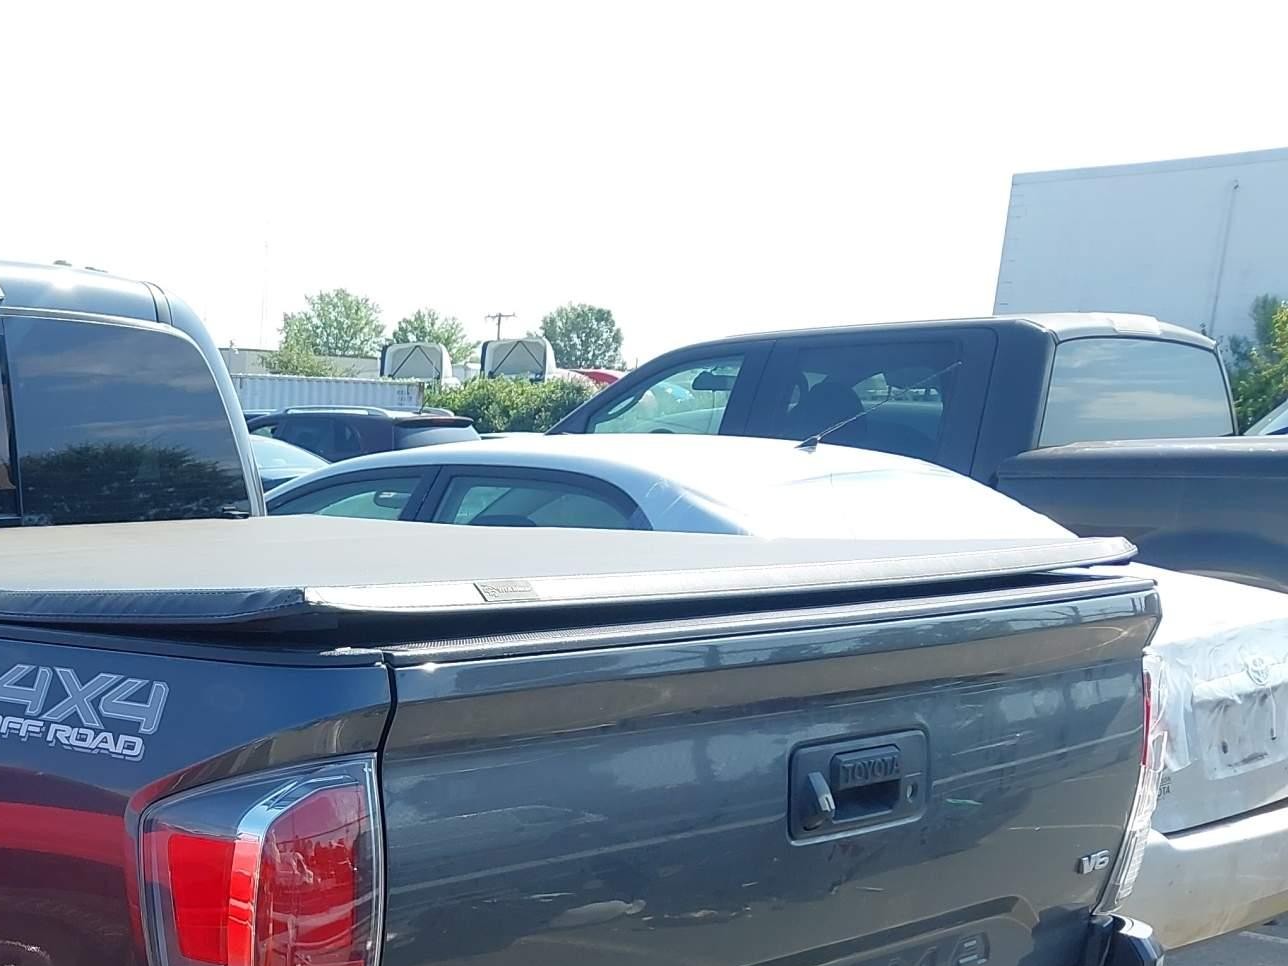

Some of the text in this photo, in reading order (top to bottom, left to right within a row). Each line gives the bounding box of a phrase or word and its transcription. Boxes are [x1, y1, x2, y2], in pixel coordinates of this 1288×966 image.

[45, 724, 146, 762] ROAD
[841, 755, 900, 785] TOYOTA
[1078, 849, 1110, 874] V6
